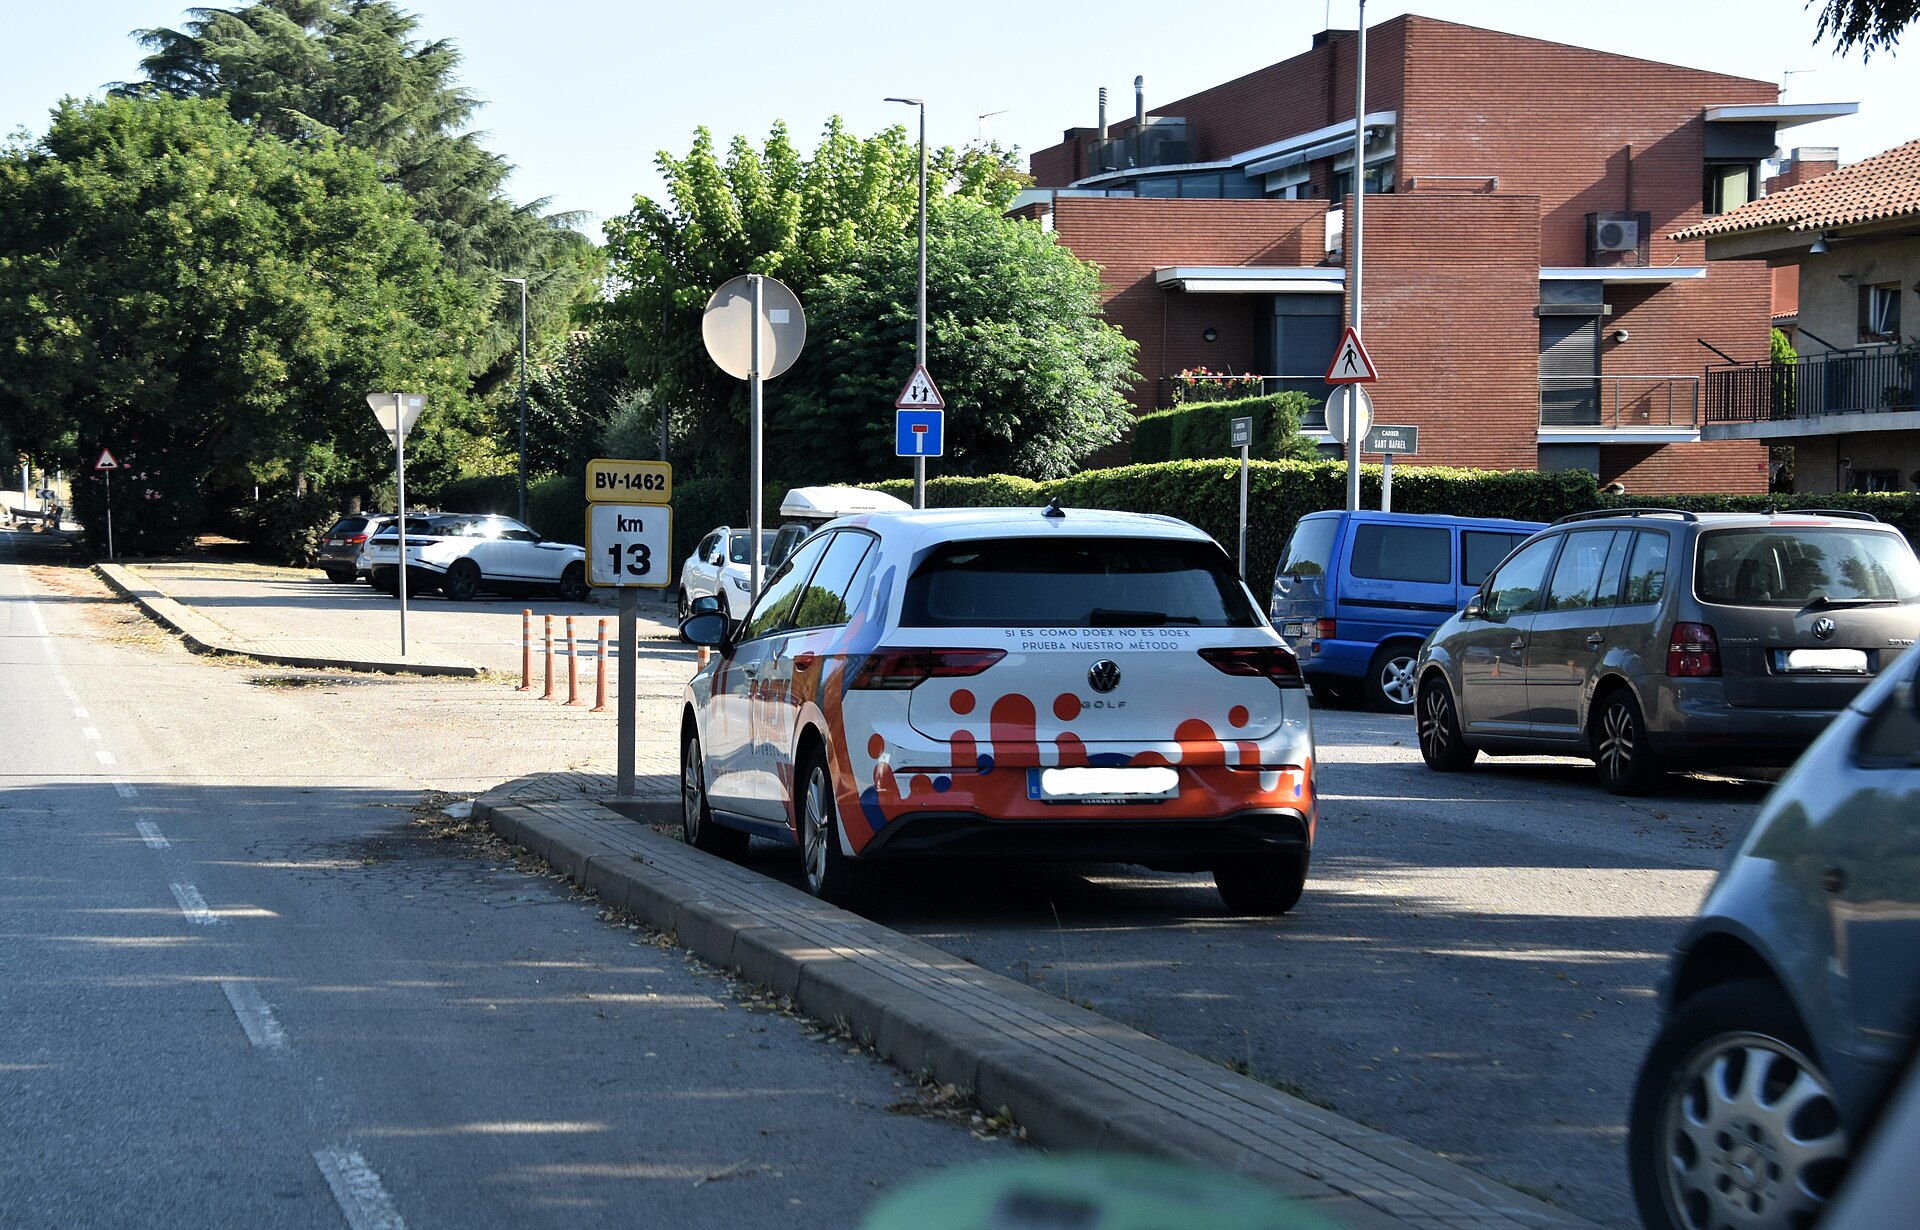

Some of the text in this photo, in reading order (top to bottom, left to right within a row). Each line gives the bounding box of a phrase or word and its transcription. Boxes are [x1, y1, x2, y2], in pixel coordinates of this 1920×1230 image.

[595, 472, 665, 491] BV-1462
[617, 514, 643, 532] km
[608, 543, 651, 576] 13
[1004, 629, 1191, 638] SI ES COMO DOEX NO ES DOEX
[1022, 640, 1179, 650] PRUEBA NUESTRO MÉTODO
[1082, 700, 1127, 709] GOLF
